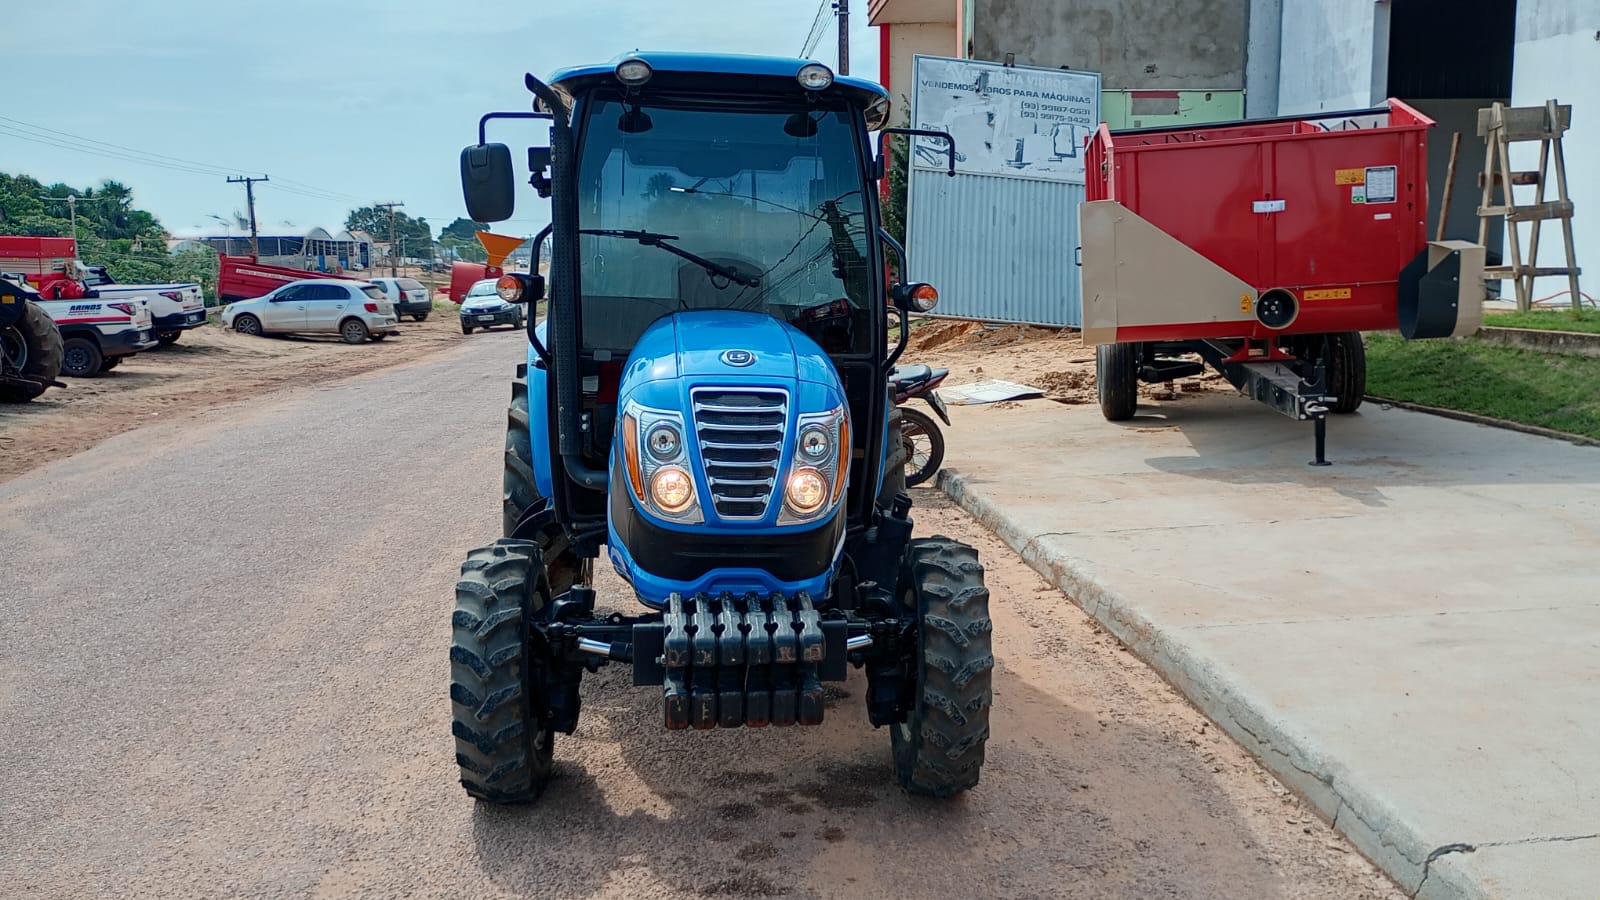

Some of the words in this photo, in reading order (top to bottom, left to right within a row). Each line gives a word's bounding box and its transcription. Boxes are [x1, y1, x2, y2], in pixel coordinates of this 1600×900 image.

[922, 80, 974, 92] VENDEMOS
[1013, 88, 1039, 98] PARA
[1041, 91, 1091, 104] MÁQUINAS
[1020, 101, 1039, 111] (93)
[1020, 110, 1038, 119] (93)
